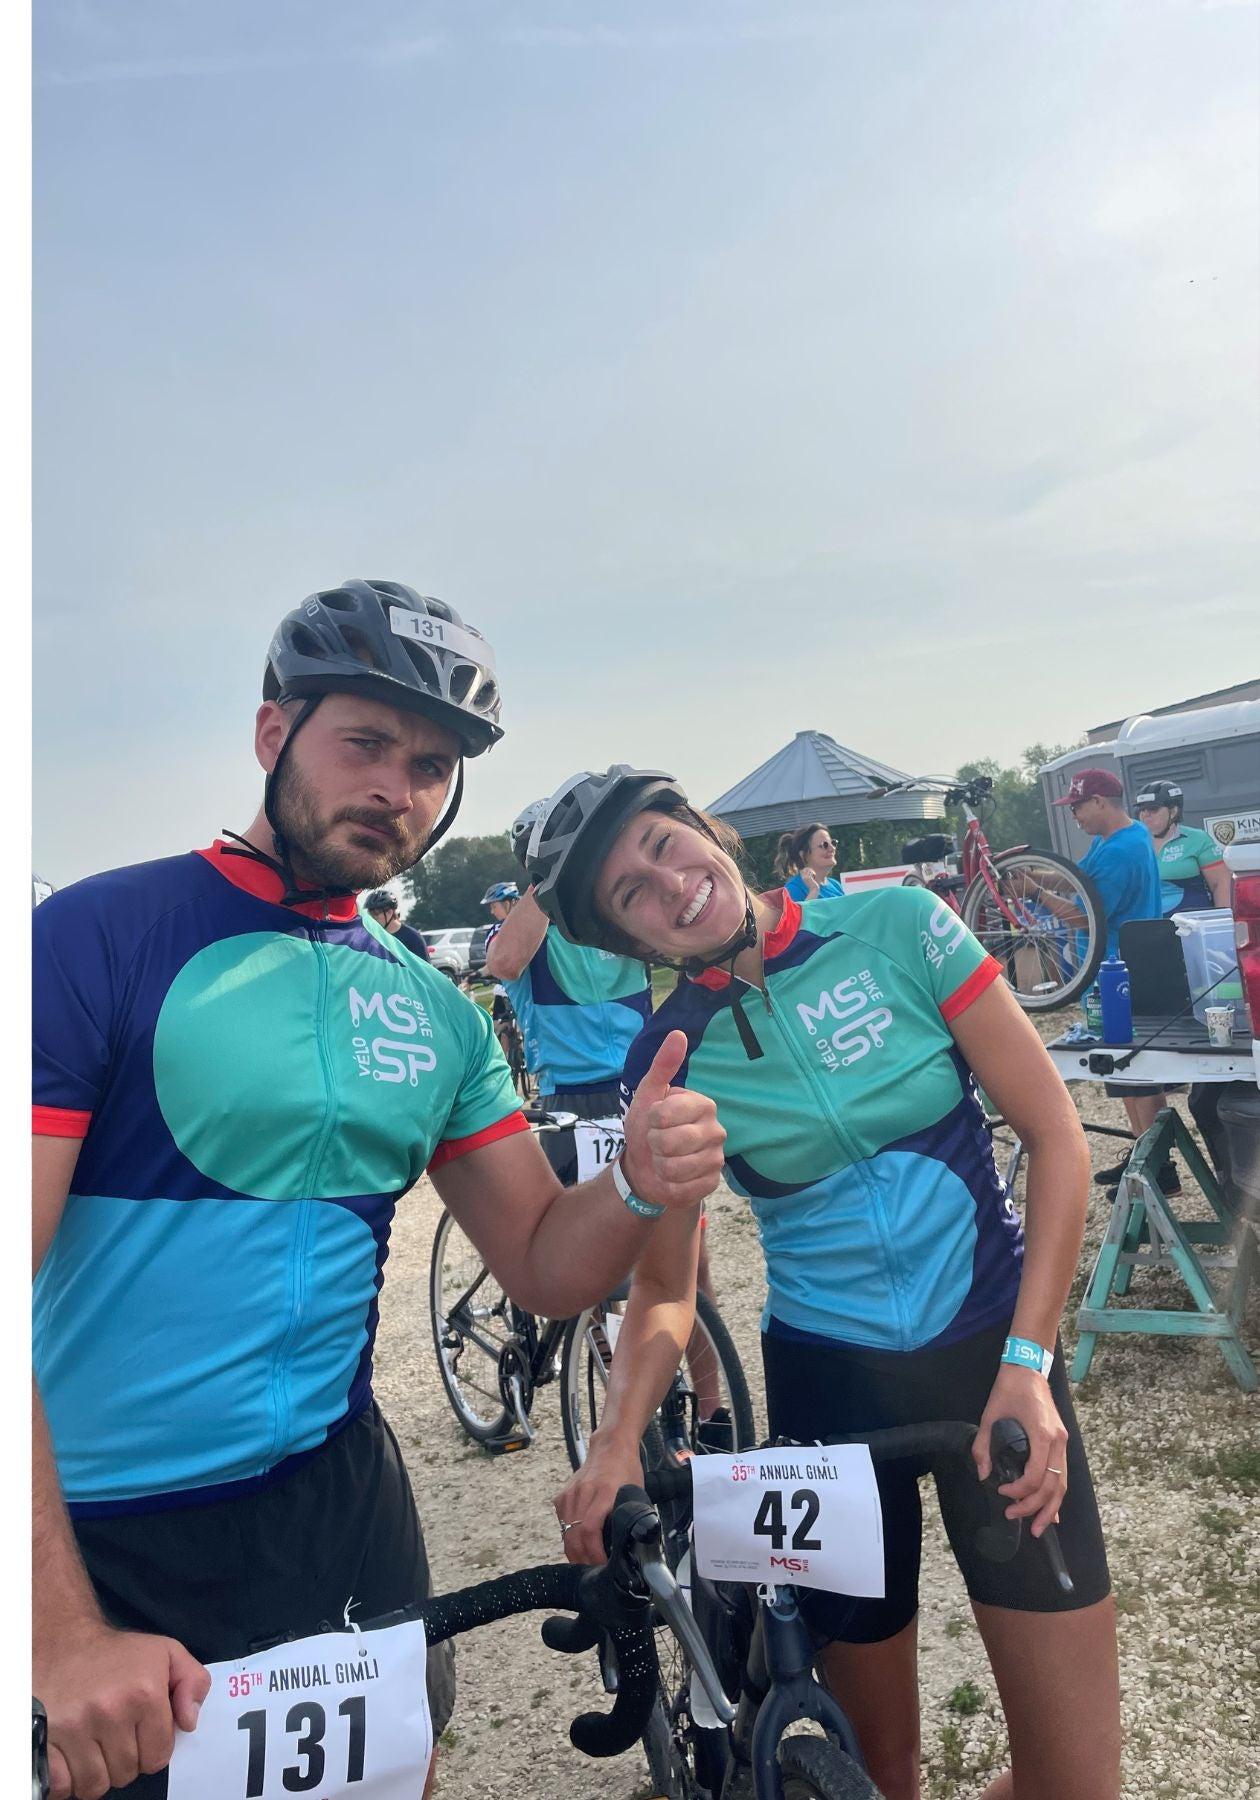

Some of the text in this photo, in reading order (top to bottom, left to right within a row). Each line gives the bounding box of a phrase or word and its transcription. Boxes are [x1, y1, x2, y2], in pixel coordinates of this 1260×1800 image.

[410, 617, 446, 642] 131
[858, 969, 884, 1001] BIKE
[348, 986, 418, 1035] MS
[412, 1000, 433, 1038] BIKE
[796, 976, 868, 1035] MS
[352, 1037, 371, 1077] VÉLO
[816, 1039, 839, 1072] VÉLO
[832, 1007, 893, 1067] SP
[371, 1037, 437, 1088] SP
[732, 1464, 838, 1481] 35TH ANNUAL GIMLI
[753, 1488, 822, 1551] 42
[770, 1556, 802, 1571] MS
[228, 1658, 379, 1698] 35TH ANNUAL GIMLI
[237, 1695, 366, 1799] 131
